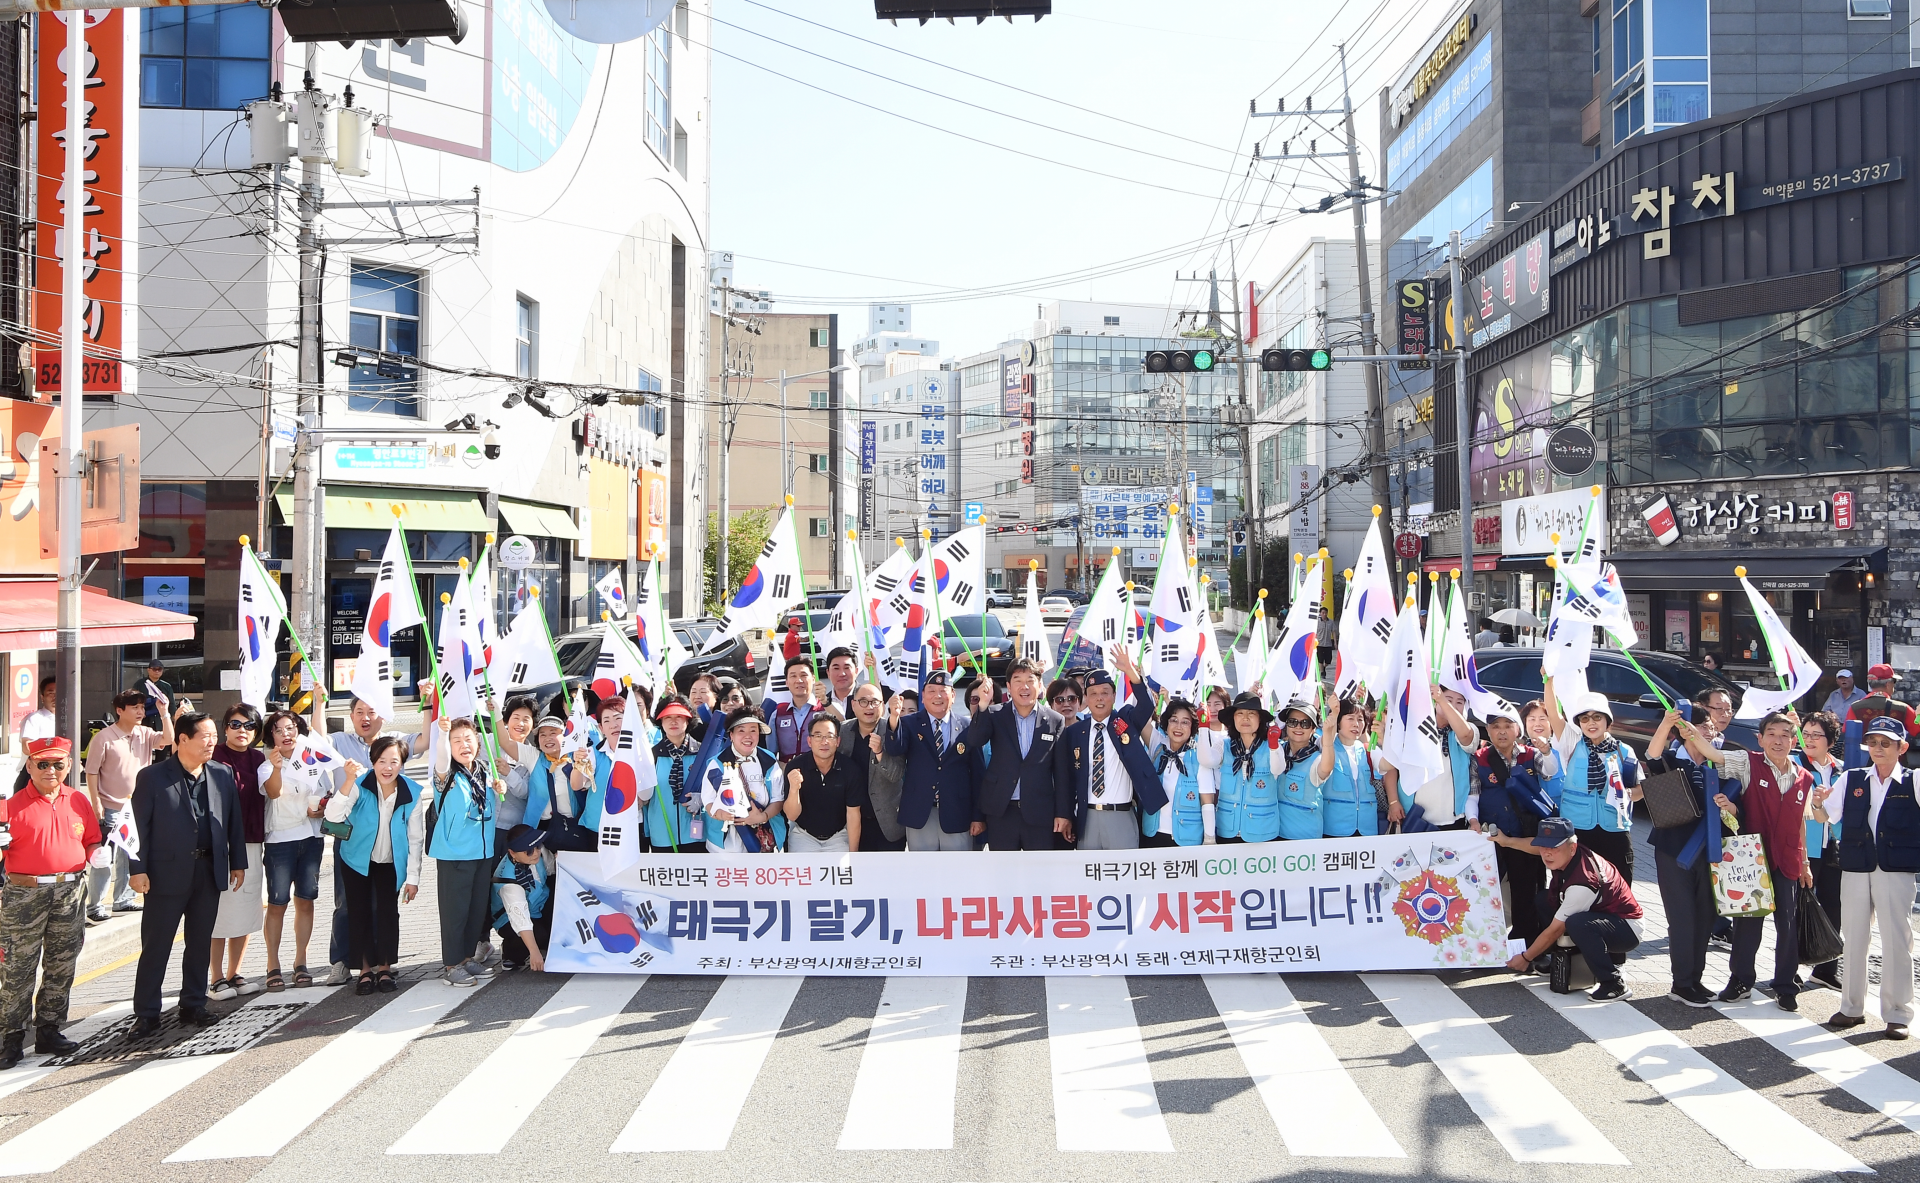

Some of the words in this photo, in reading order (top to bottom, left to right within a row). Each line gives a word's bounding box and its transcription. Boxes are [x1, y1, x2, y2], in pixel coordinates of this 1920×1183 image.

[502, 57, 522, 113] 6층
[526, 82, 556, 148] 입원실
[1761, 179, 1806, 199] 예약문의
[1812, 163, 1891, 193] 521-3737
[1578, 207, 1611, 254] 야노
[1631, 171, 1736, 260] 참치
[1480, 237, 1542, 320] 노래방
[1401, 282, 1425, 308] S
[1006, 363, 1020, 386] 관절
[921, 404, 946, 420] 무릎
[1493, 377, 1513, 458] S
[920, 429, 946, 445] 로봇
[1022, 373, 1034, 483] 미래병원
[864, 431, 873, 466] 세무회계
[1514, 433, 1531, 457] 에스
[920, 454, 946, 470] 어깨
[920, 478, 945, 494] 허리
[1107, 466, 1179, 485] 미래병
[1300, 481, 1310, 489] 88
[1498, 467, 1524, 497] 노래방
[1534, 468, 1545, 486] 2층
[1095, 506, 1128, 520] 무릎
[1685, 493, 1828, 535] 하삼동커피
[20, 674, 29, 693] P
[639, 867, 709, 887] 대한민국
[714, 867, 749, 888] 광복
[755, 867, 813, 887] 80주년
[820, 866, 853, 887] 기념
[1084, 863, 1157, 882] 태극기와
[1162, 860, 1199, 880] 함께
[1204, 857, 1238, 877] GO!
[1244, 856, 1278, 875] GO!
[1284, 854, 1317, 874] GO!
[1322, 849, 1377, 871] 캠페인
[1731, 865, 1745, 876] I'm
[1727, 870, 1757, 885] fresh!
[668, 899, 791, 942] 태극기
[808, 897, 903, 945] 달기,
[917, 893, 1133, 941] 나라사랑의
[1149, 882, 1384, 934] 시작입니다!!
[697, 956, 732, 971] 주최
[747, 955, 922, 971] 부산광역시재향군인회
[989, 954, 1024, 970] 주관
[1041, 952, 1129, 969] 부산광역시
[1136, 945, 1321, 968] 동래·연제구재향군인회
